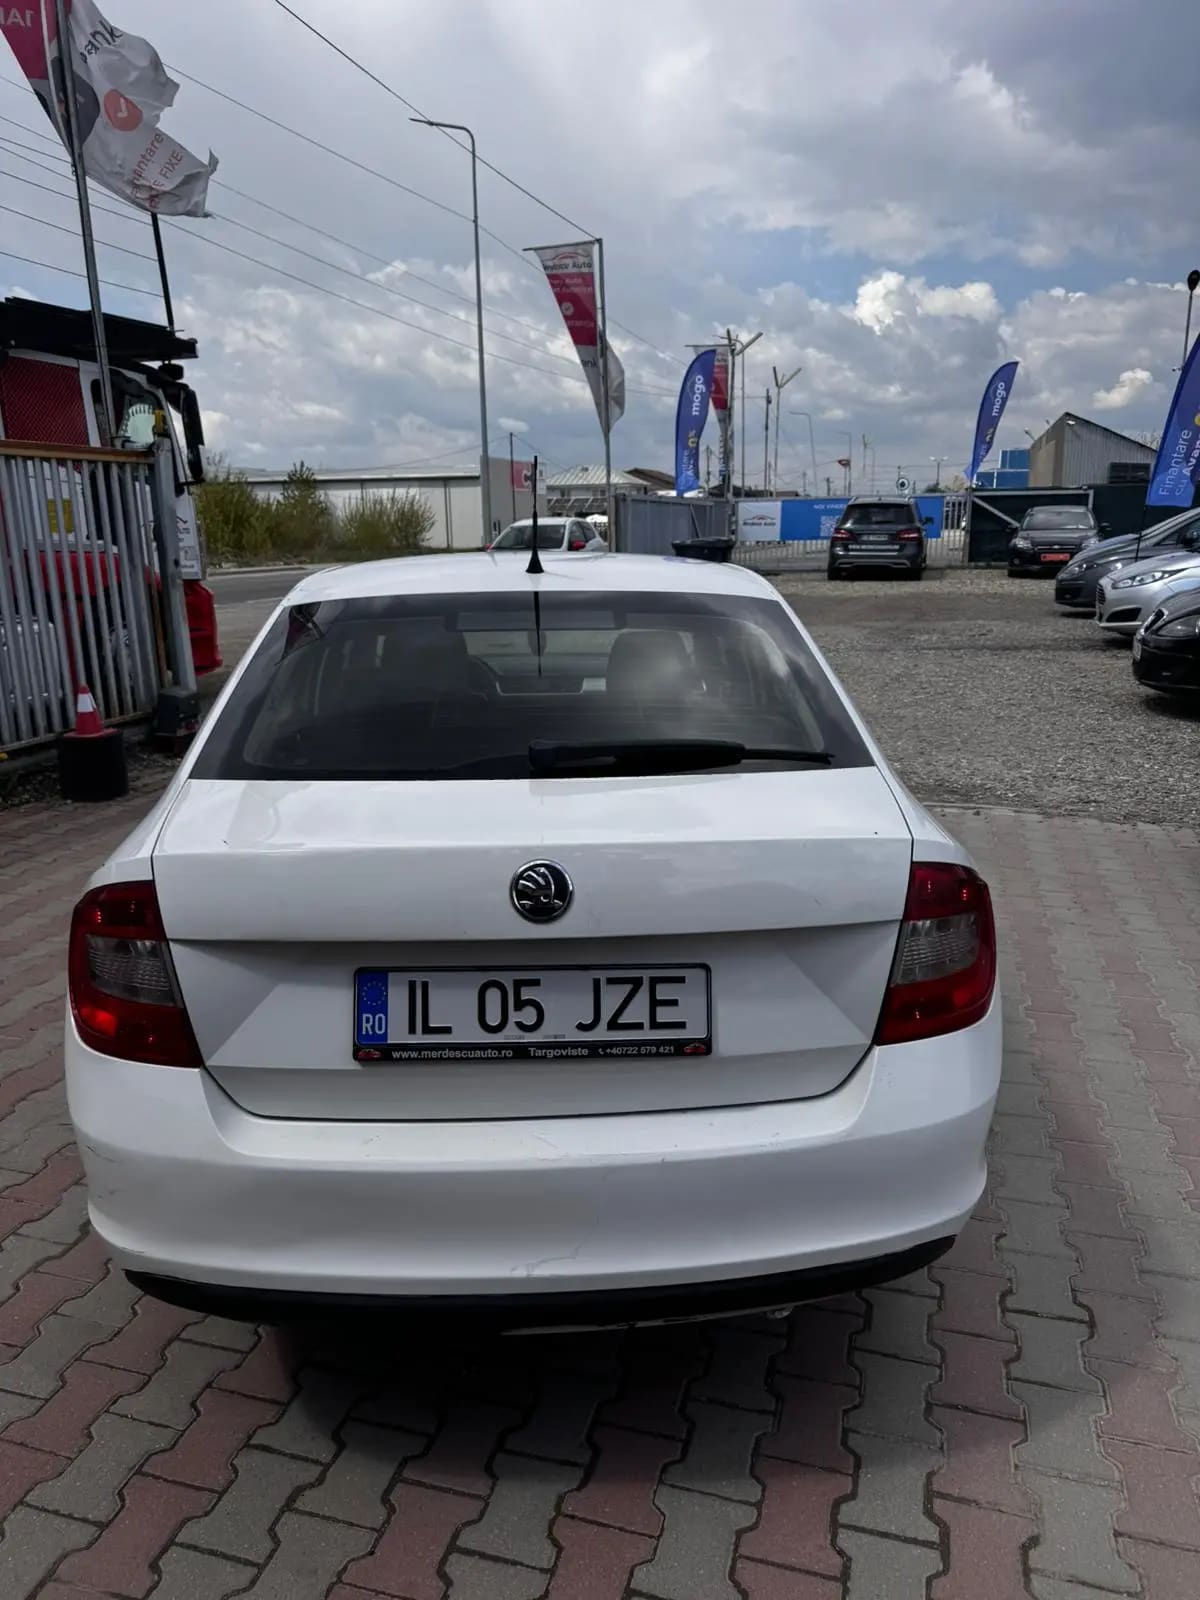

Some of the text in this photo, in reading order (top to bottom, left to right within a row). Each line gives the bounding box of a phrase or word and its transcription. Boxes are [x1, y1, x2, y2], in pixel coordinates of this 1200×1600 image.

[158, 149, 184, 180] FIXE
[692, 375, 706, 416] mogo
[992, 382, 1007, 417] mogo
[1158, 429, 1192, 496] Finantare
[408, 976, 687, 1035] IL 05 JZE
[362, 1013, 386, 1035] RO
[391, 1048, 514, 1059] www.merdescuauto.ro
[528, 1047, 589, 1059] Targoviste
